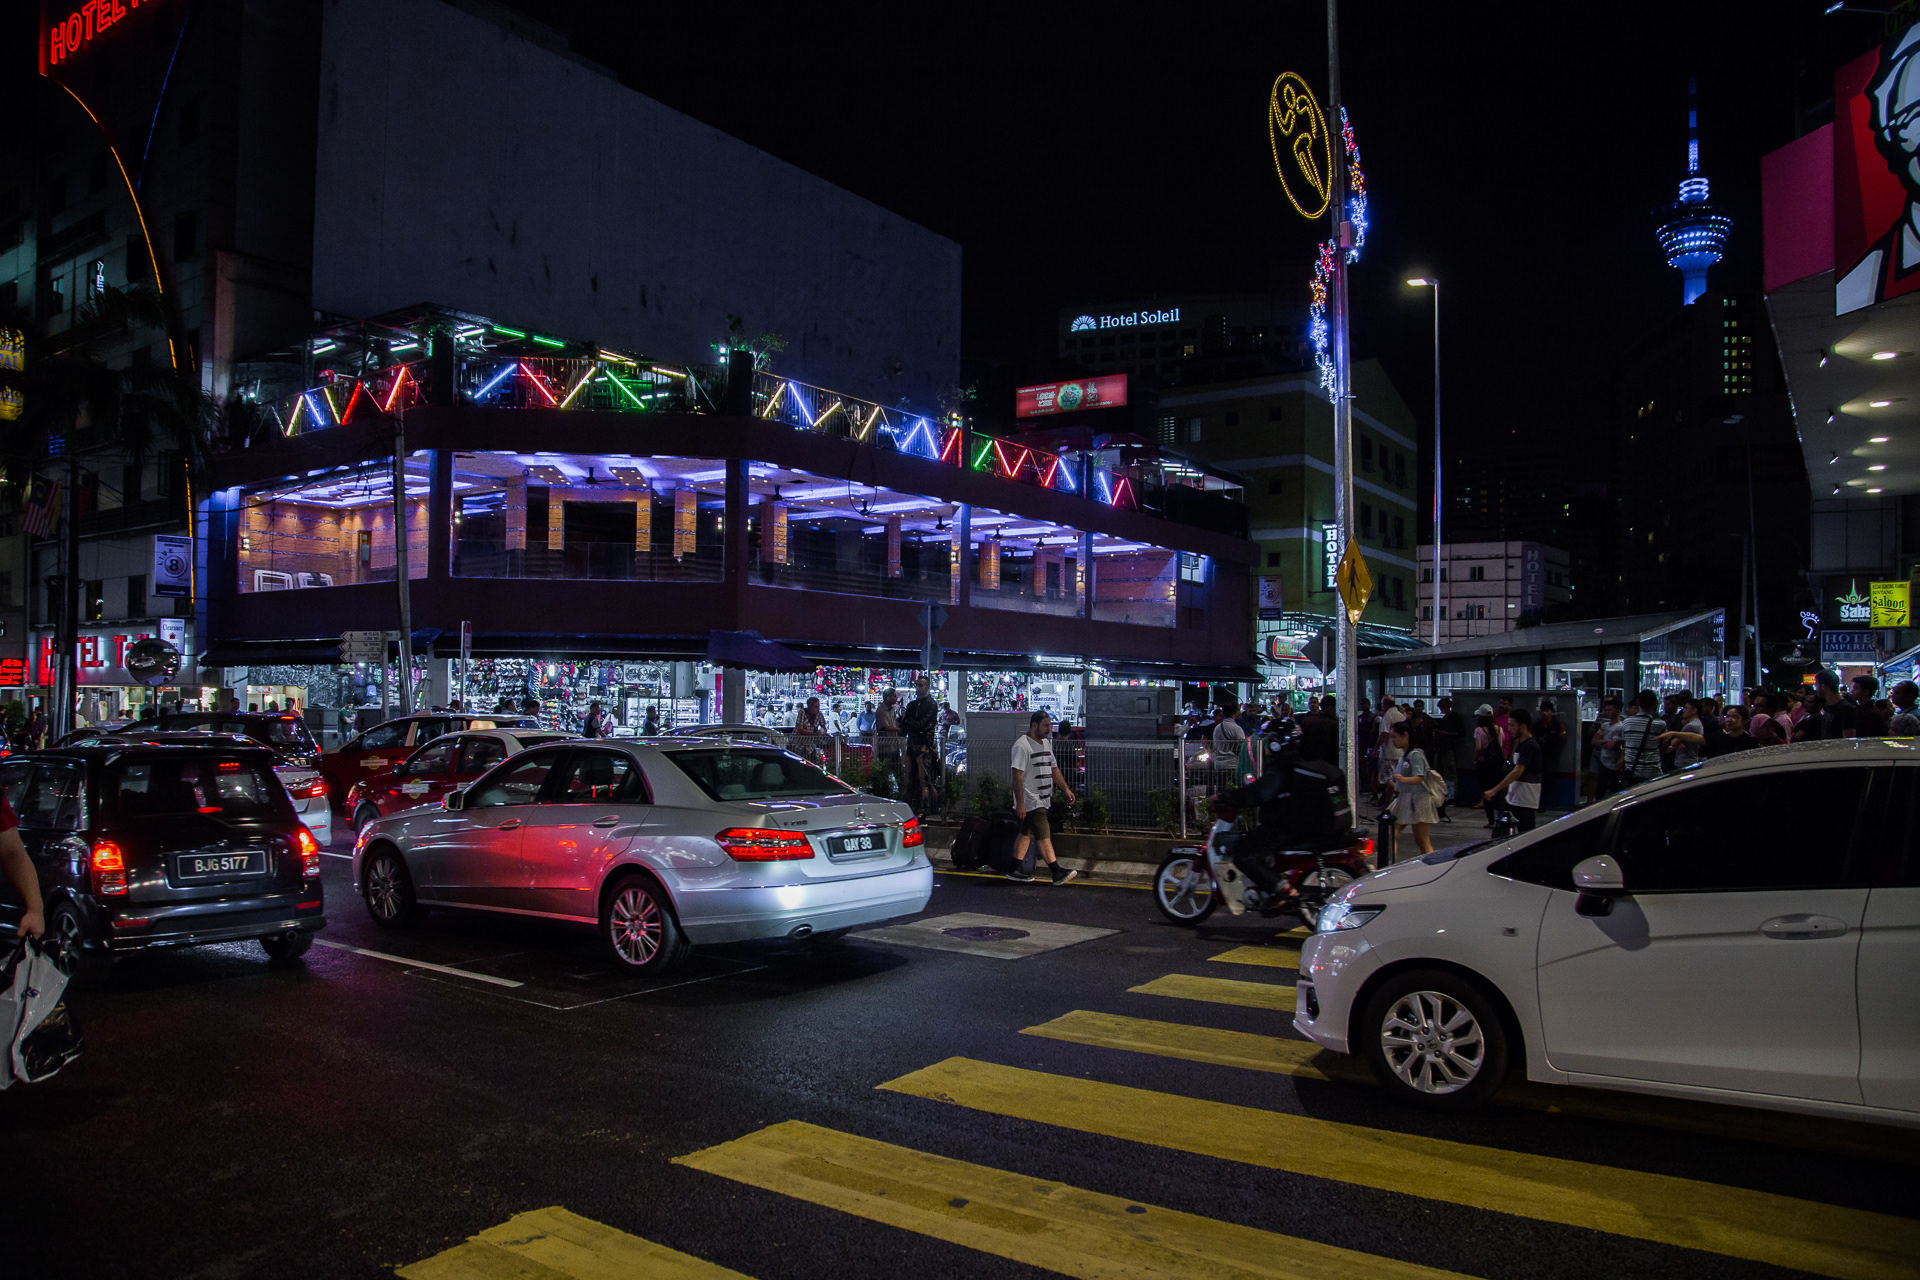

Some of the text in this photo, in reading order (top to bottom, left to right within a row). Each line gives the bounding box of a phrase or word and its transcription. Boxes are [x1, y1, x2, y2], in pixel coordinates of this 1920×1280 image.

[51, 0, 125, 64] HOTEL
[1100, 308, 1180, 328] Hotel Soleil
[157, 548, 174, 566] LIVE
[169, 558, 179, 571] 8
[1326, 529, 1338, 588] HOTEL
[1527, 550, 1540, 606] HOTEL
[1267, 590, 1274, 599] 8
[1872, 595, 1905, 609] Saloon
[1840, 603, 1870, 618] Saba
[1825, 633, 1872, 643] HOTE
[42, 636, 104, 668] HEL
[1825, 643, 1875, 651] IMPERIA
[843, 836, 873, 852] QAY 38
[194, 855, 249, 873] BJG 5177
